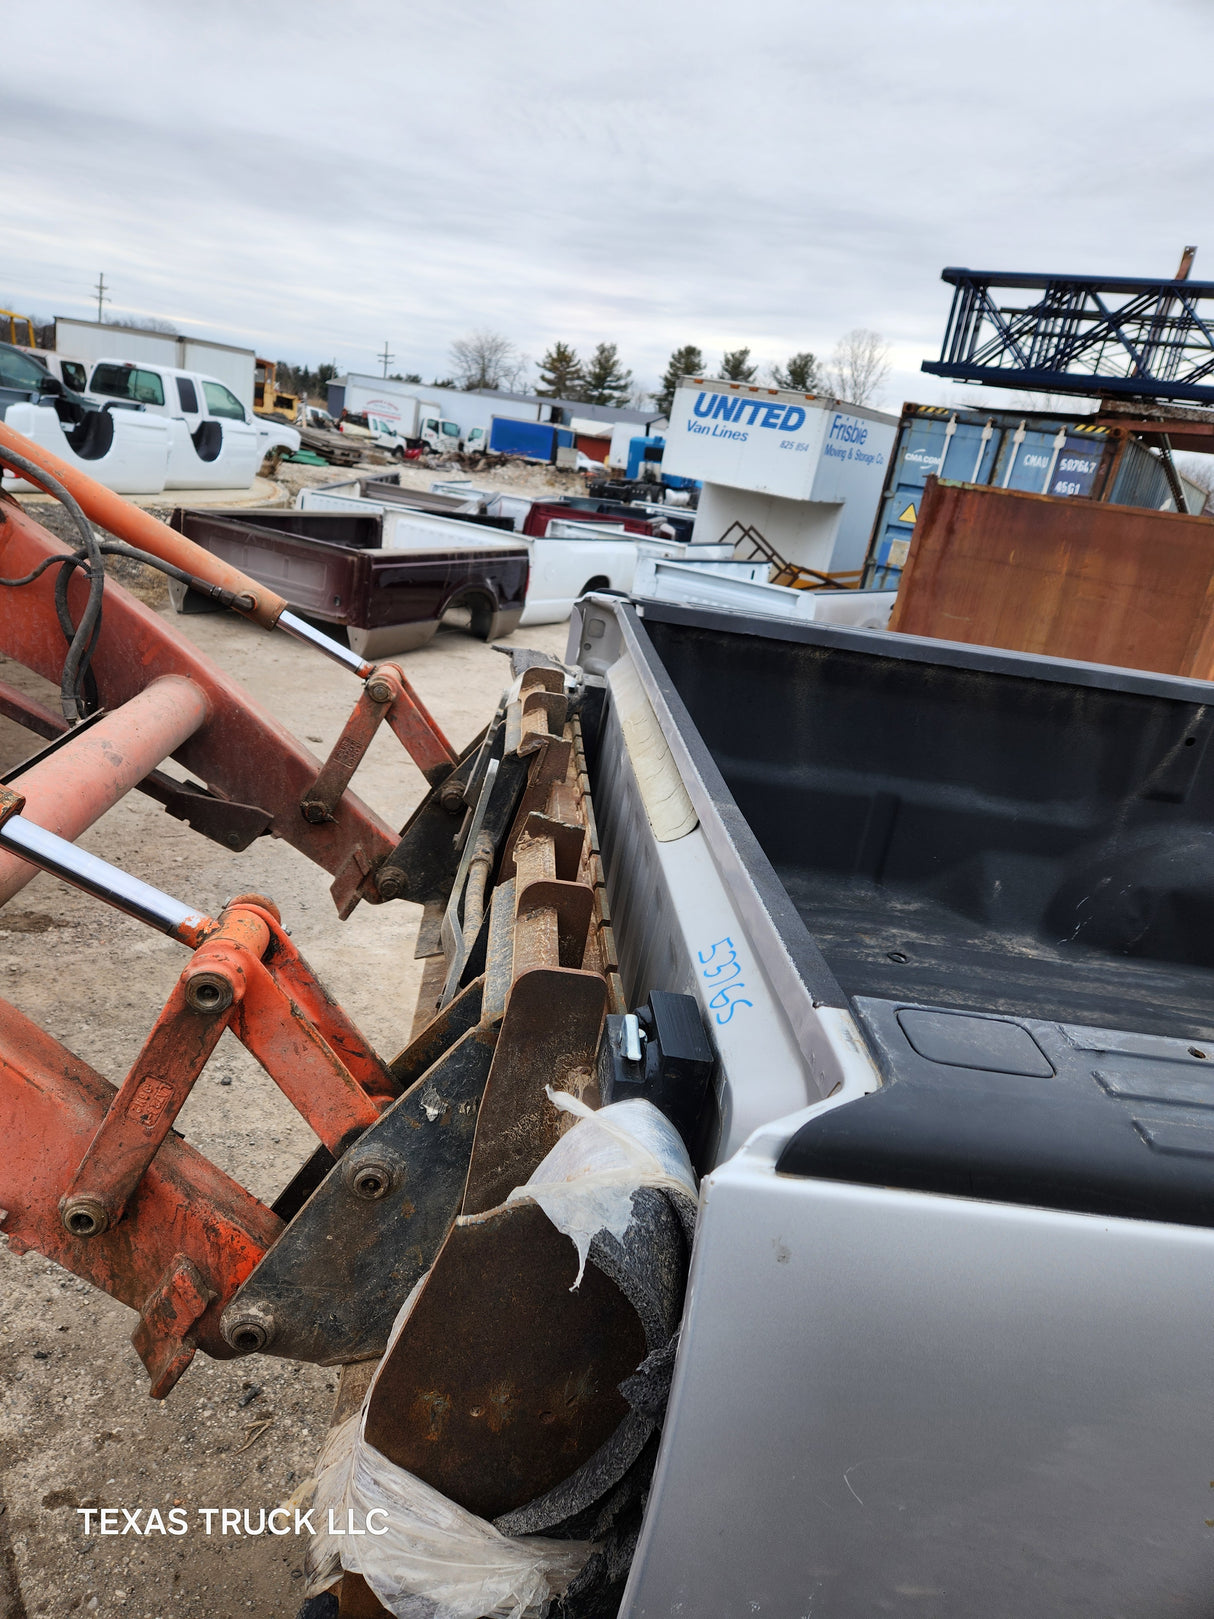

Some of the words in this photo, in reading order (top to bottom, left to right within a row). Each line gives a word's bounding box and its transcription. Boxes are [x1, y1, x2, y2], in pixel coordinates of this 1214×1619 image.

[693, 392, 806, 432] UNITED
[687, 420, 711, 434] Van
[712, 424, 749, 442] Lines
[829, 414, 867, 445] Frisbie
[824, 444, 846, 461] Moving
[848, 448, 853, 459] &
[855, 449, 875, 465] Storage
[905, 453, 922, 461] CMA
[1024, 454, 1050, 468] CMAU
